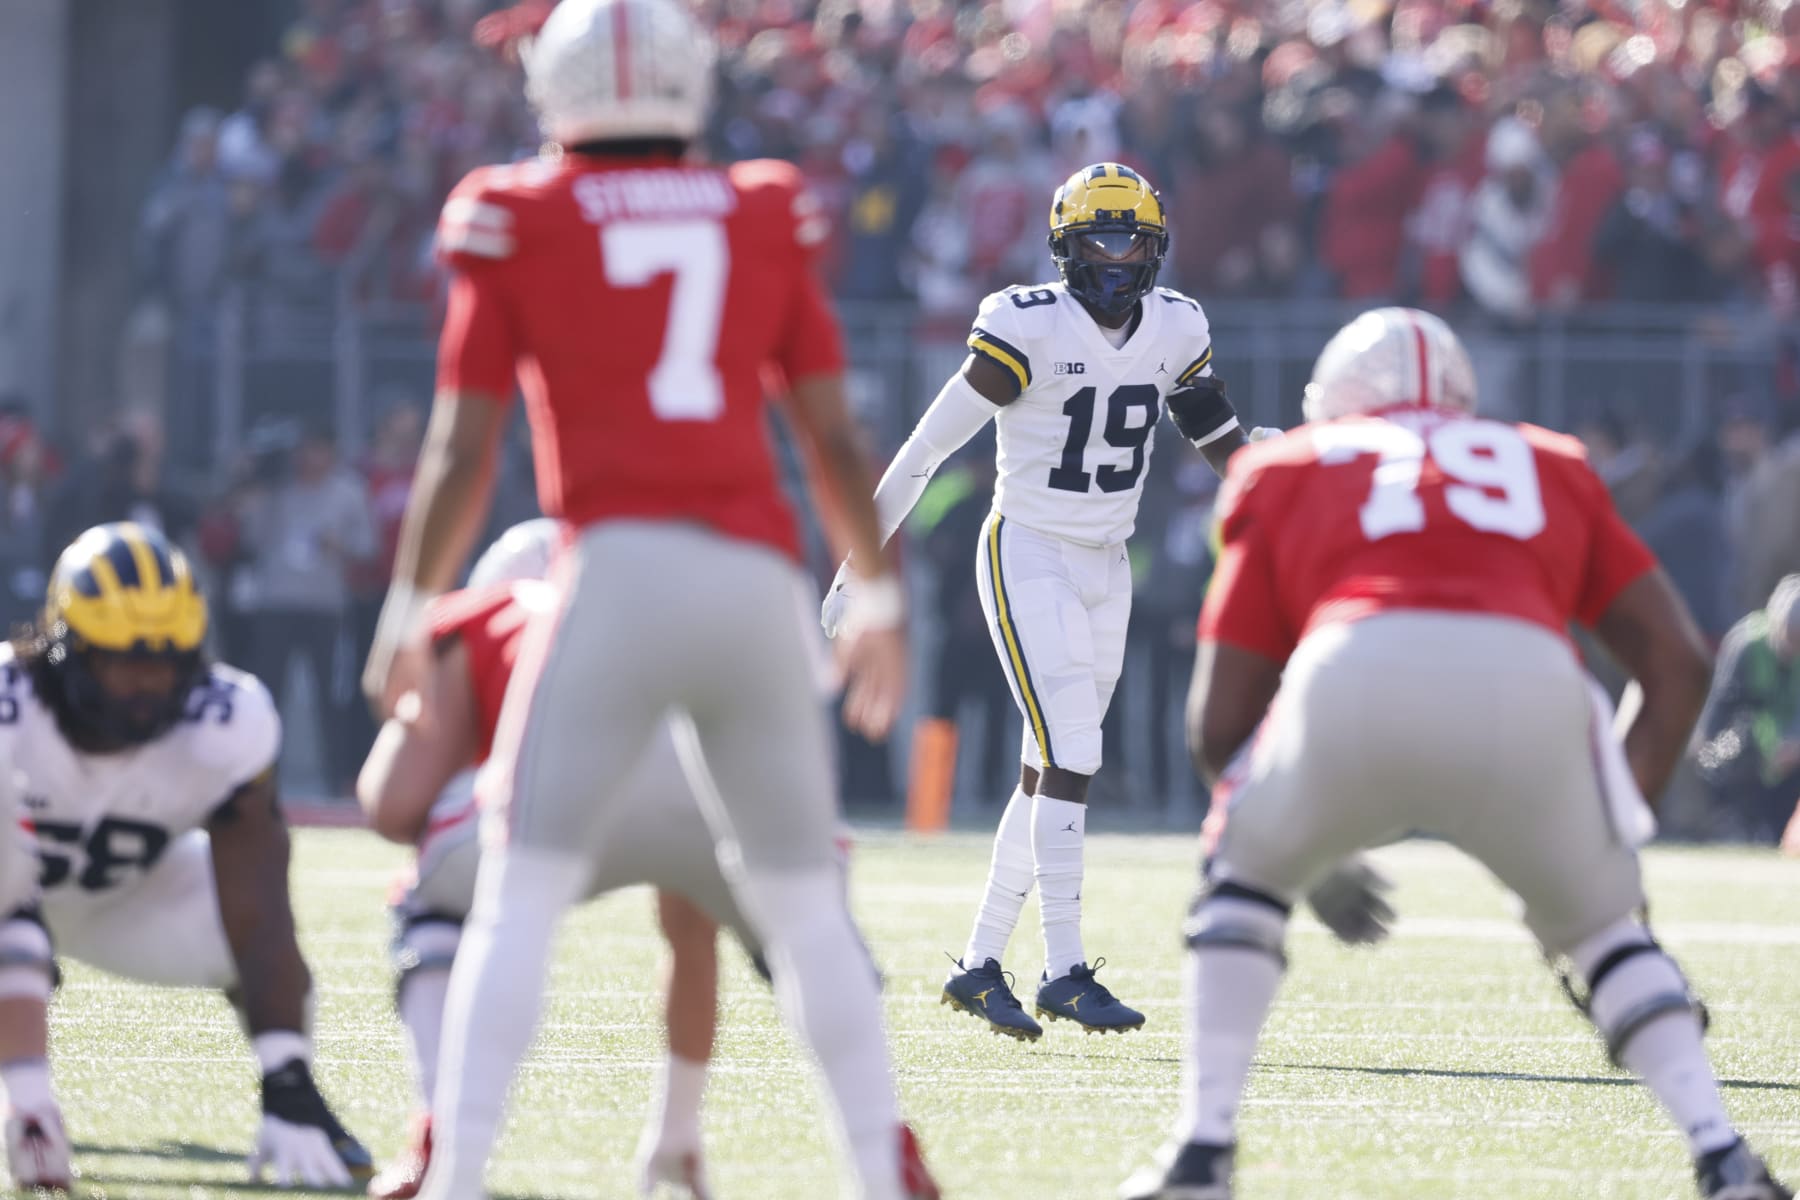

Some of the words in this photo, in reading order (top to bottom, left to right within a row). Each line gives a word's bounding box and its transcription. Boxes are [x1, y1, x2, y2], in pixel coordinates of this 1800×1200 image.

[601, 221, 728, 420] 7
[1048, 384, 1159, 493] 19
[1312, 422, 1546, 541] 79
[33, 815, 169, 890] 58
